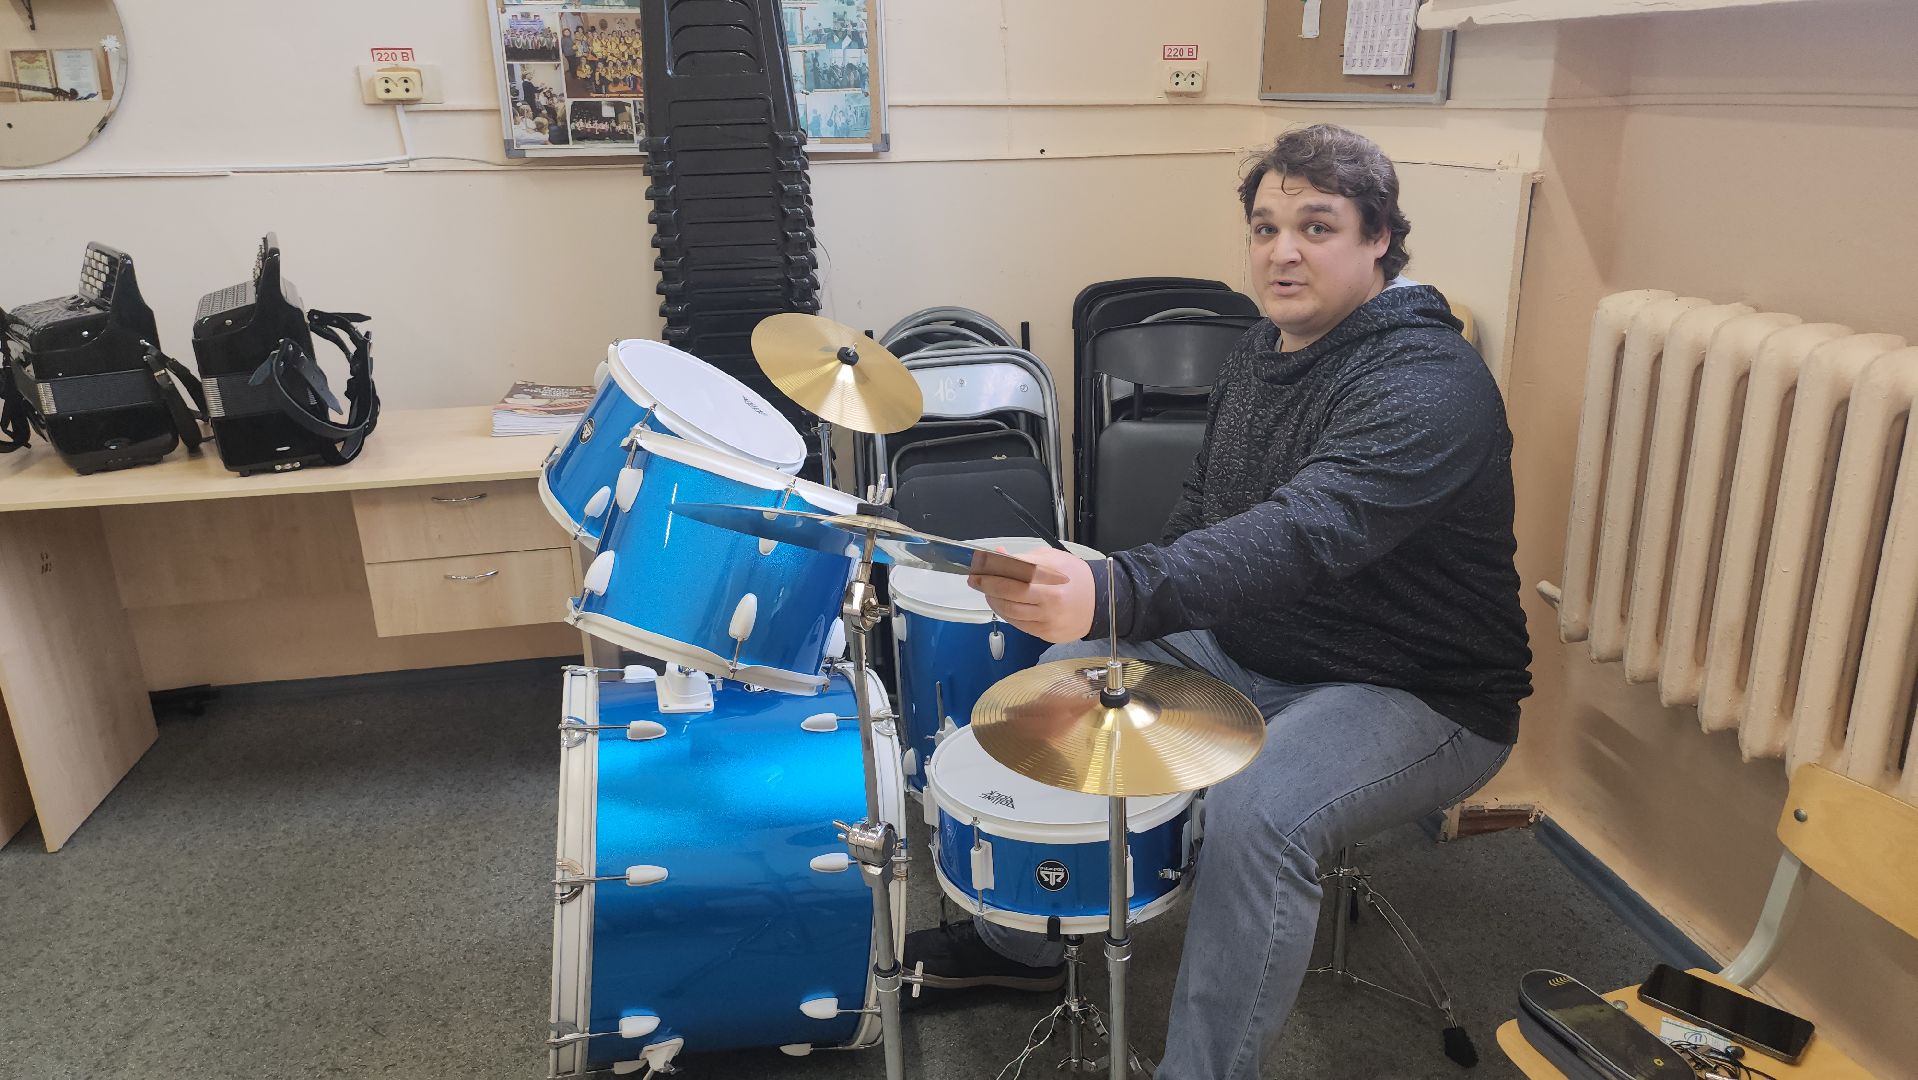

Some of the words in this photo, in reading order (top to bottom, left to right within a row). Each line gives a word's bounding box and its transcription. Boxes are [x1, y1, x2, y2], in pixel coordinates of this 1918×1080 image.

[376, 52, 398, 62] 220
[401, 52, 410, 62] В
[1167, 48, 1184, 57] 220
[1187, 48, 1194, 57] В
